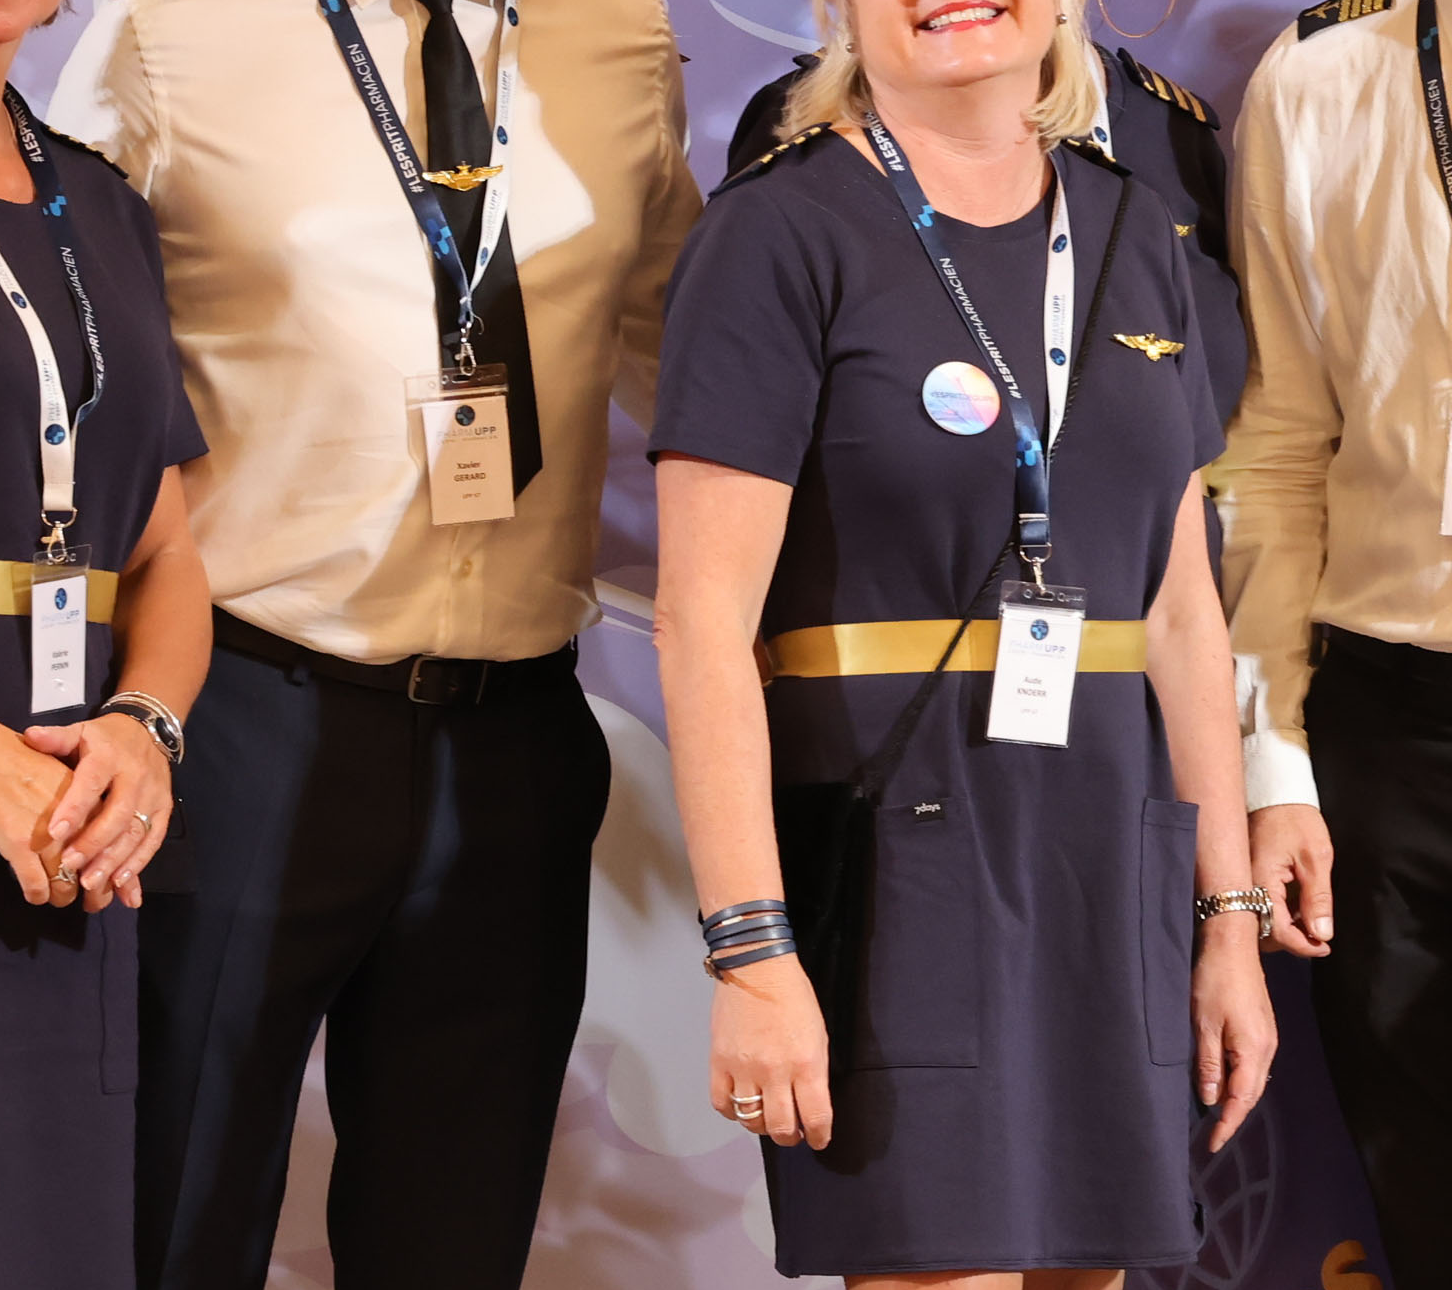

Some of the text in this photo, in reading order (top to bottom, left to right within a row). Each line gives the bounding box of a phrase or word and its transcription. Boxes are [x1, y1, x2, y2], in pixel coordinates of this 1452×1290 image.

[347, 43, 424, 194] #LESPRITPHARMACIEN
[939, 257, 1023, 399] #LESPRITPHARMACIEN
[454, 472, 486, 482] GERARD
